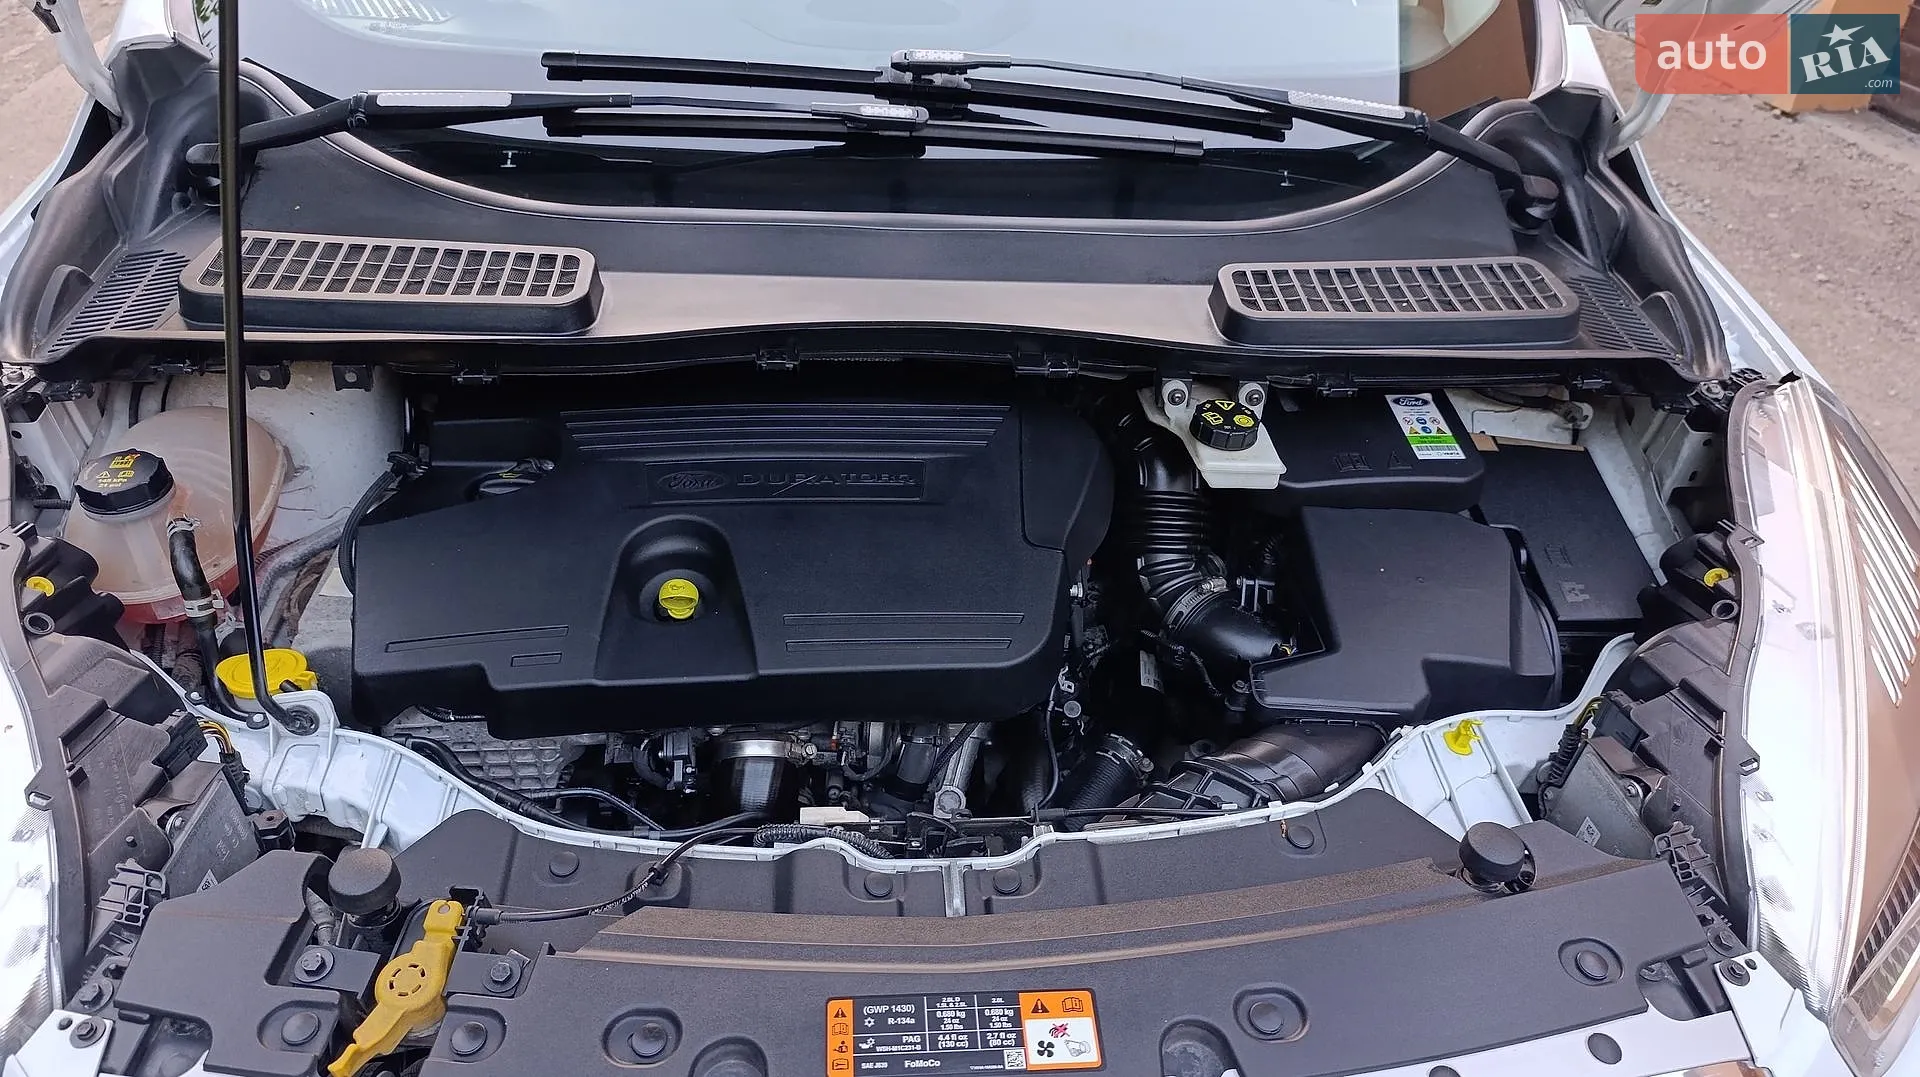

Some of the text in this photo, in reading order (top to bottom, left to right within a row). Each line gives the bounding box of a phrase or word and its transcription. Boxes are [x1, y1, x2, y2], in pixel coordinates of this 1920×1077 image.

[1398, 396, 1425, 406] Ford
[665, 472, 720, 491] Ford
[863, 1004, 915, 1015] (GWP 1430)
[956, 1010, 966, 1018] kg
[1004, 1008, 1014, 1016] kg
[902, 1035, 921, 1043] PAG
[989, 1039, 1015, 1047] (80 cc)
[938, 1040, 969, 1049] (130 cc)
[904, 1059, 941, 1068] FoMoCo
